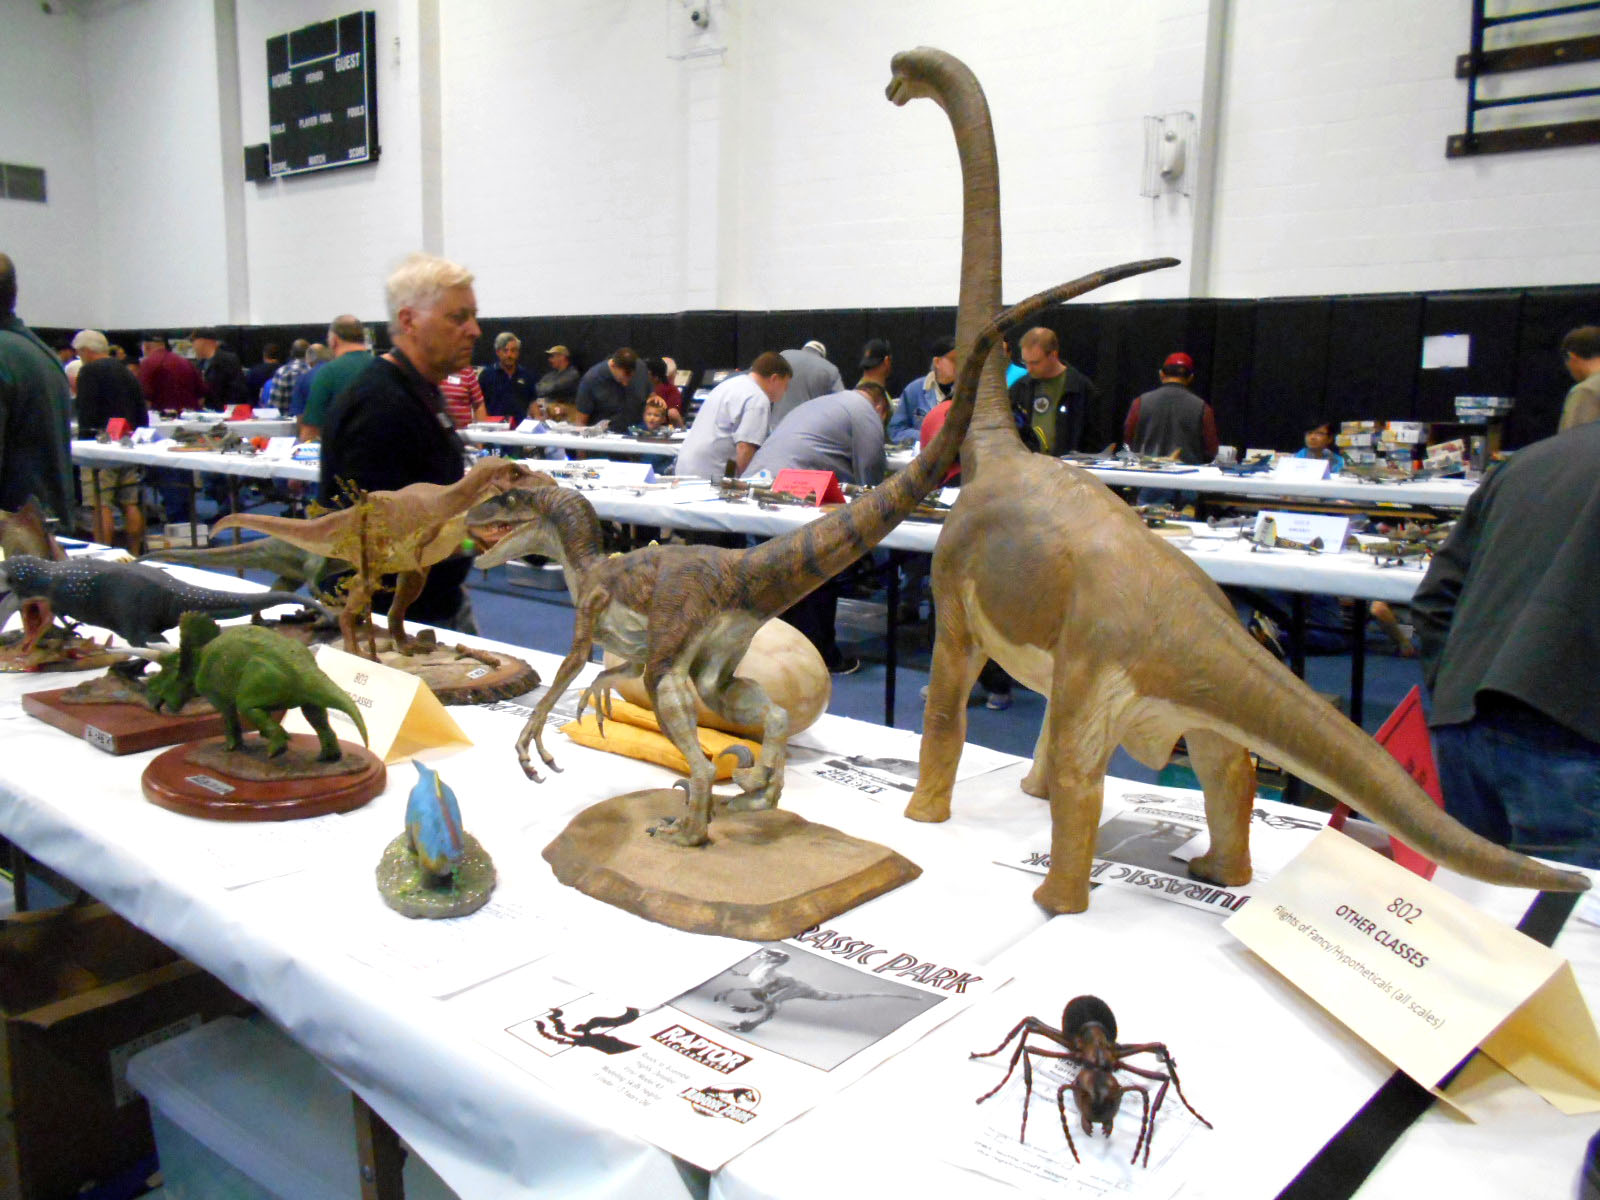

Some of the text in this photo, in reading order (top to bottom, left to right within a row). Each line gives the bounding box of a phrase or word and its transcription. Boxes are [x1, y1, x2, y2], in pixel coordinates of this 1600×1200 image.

[335, 52, 360, 72] GUEST
[1109, 866, 1252, 912] JURASSIC
[1386, 897, 1423, 925] 802
[1335, 904, 1430, 969] OTHER CLASSES
[871, 952, 984, 994] PARK
[1273, 904, 1446, 1030] Flights of Fancy/Hypotheticals (all scales)
[660, 1026, 745, 1069] RAPTOR
